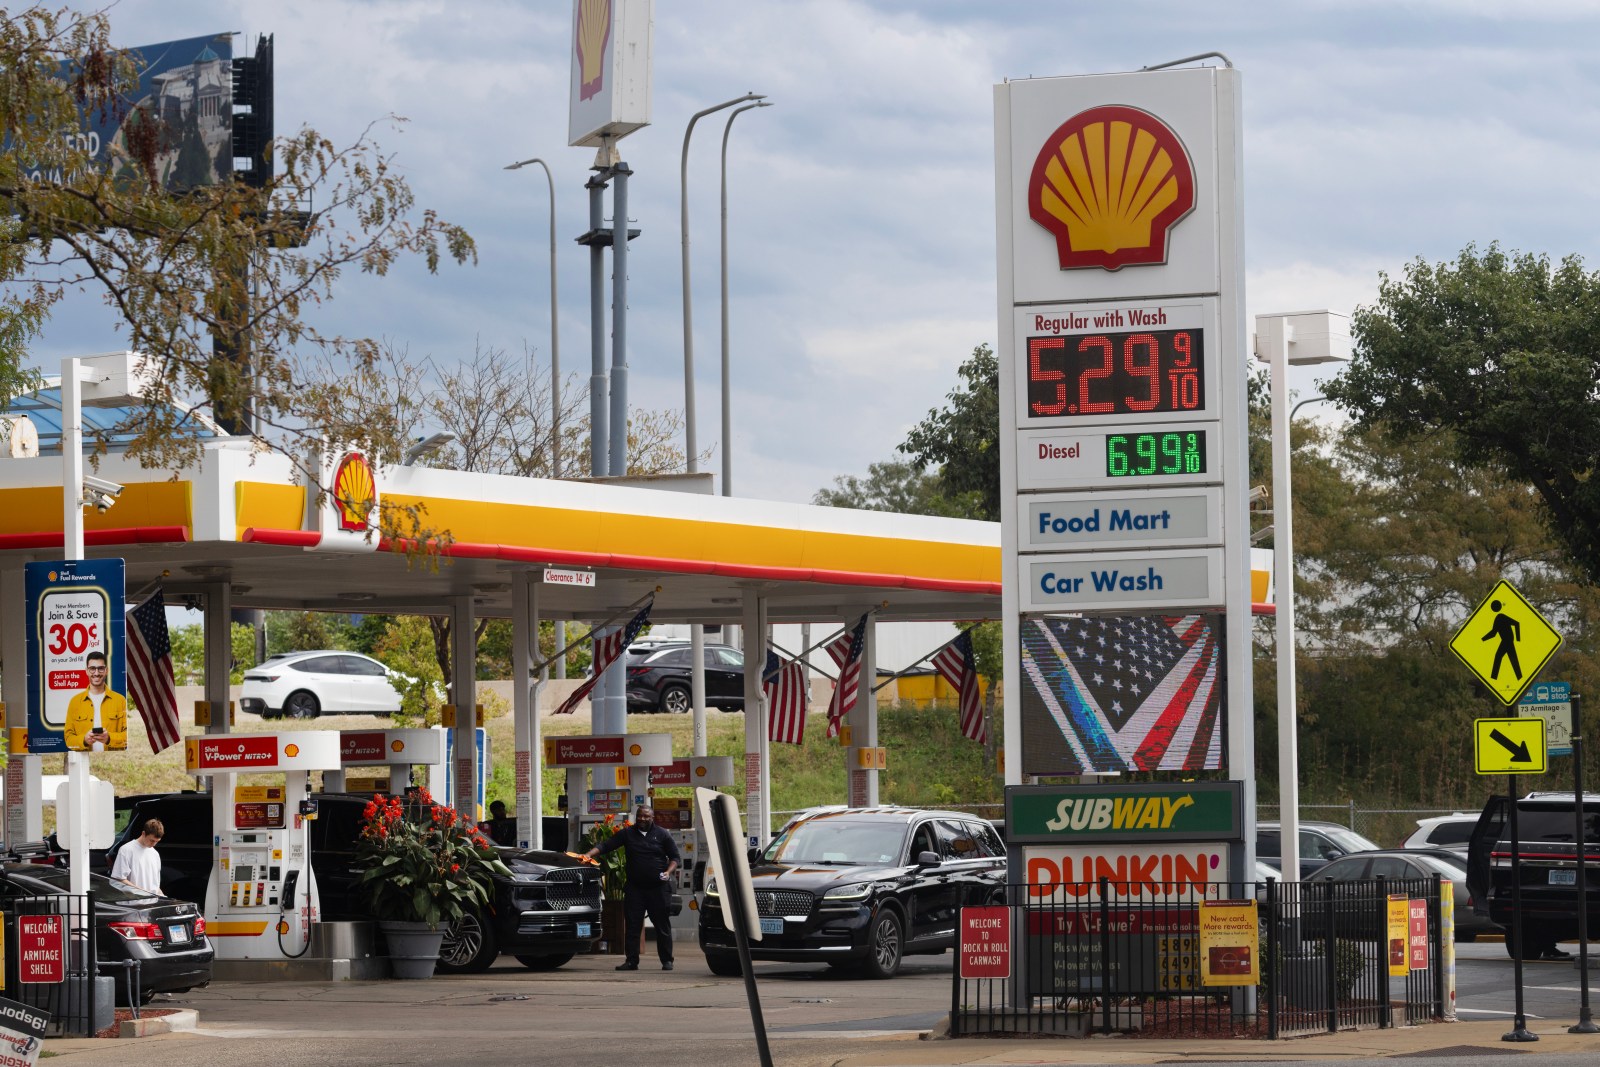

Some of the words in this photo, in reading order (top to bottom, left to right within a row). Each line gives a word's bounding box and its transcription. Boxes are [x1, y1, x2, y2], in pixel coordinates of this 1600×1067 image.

[1035, 312, 1089, 334] Regular
[1093, 310, 1124, 328] with
[1128, 308, 1167, 326] Wash
[1030, 333, 1160, 415] 5.29
[1038, 442, 1080, 460] Diesel
[1108, 433, 1182, 476] 6.99
[1038, 508, 1100, 534] Food
[1109, 509, 1171, 531] Mart
[545, 570, 574, 584] Clearance
[1040, 572, 1084, 594] Car
[1091, 567, 1163, 592] Wash
[48, 611, 64, 620] Join
[66, 610, 74, 619] &
[76, 610, 99, 619] Save
[66, 680, 78, 688] App
[188, 748, 194, 762] 2
[205, 752, 242, 761] V-Power
[867, 752, 871, 764] 9
[618, 770, 625, 779] 11
[1046, 793, 1195, 832] SUBWAY
[1028, 853, 1220, 898] DUNKIN'
[24, 923, 58, 934] WELCOME
[969, 919, 1001, 929] WELCOME
[37, 937, 44, 946] TO
[981, 931, 989, 941] TO
[963, 943, 982, 953] ROCK
[983, 943, 988, 953] N
[991, 943, 1008, 953] ROLL
[24, 950, 59, 961] ARMITAGE
[969, 956, 1001, 966] CARWASH
[30, 964, 53, 975] SHELL
